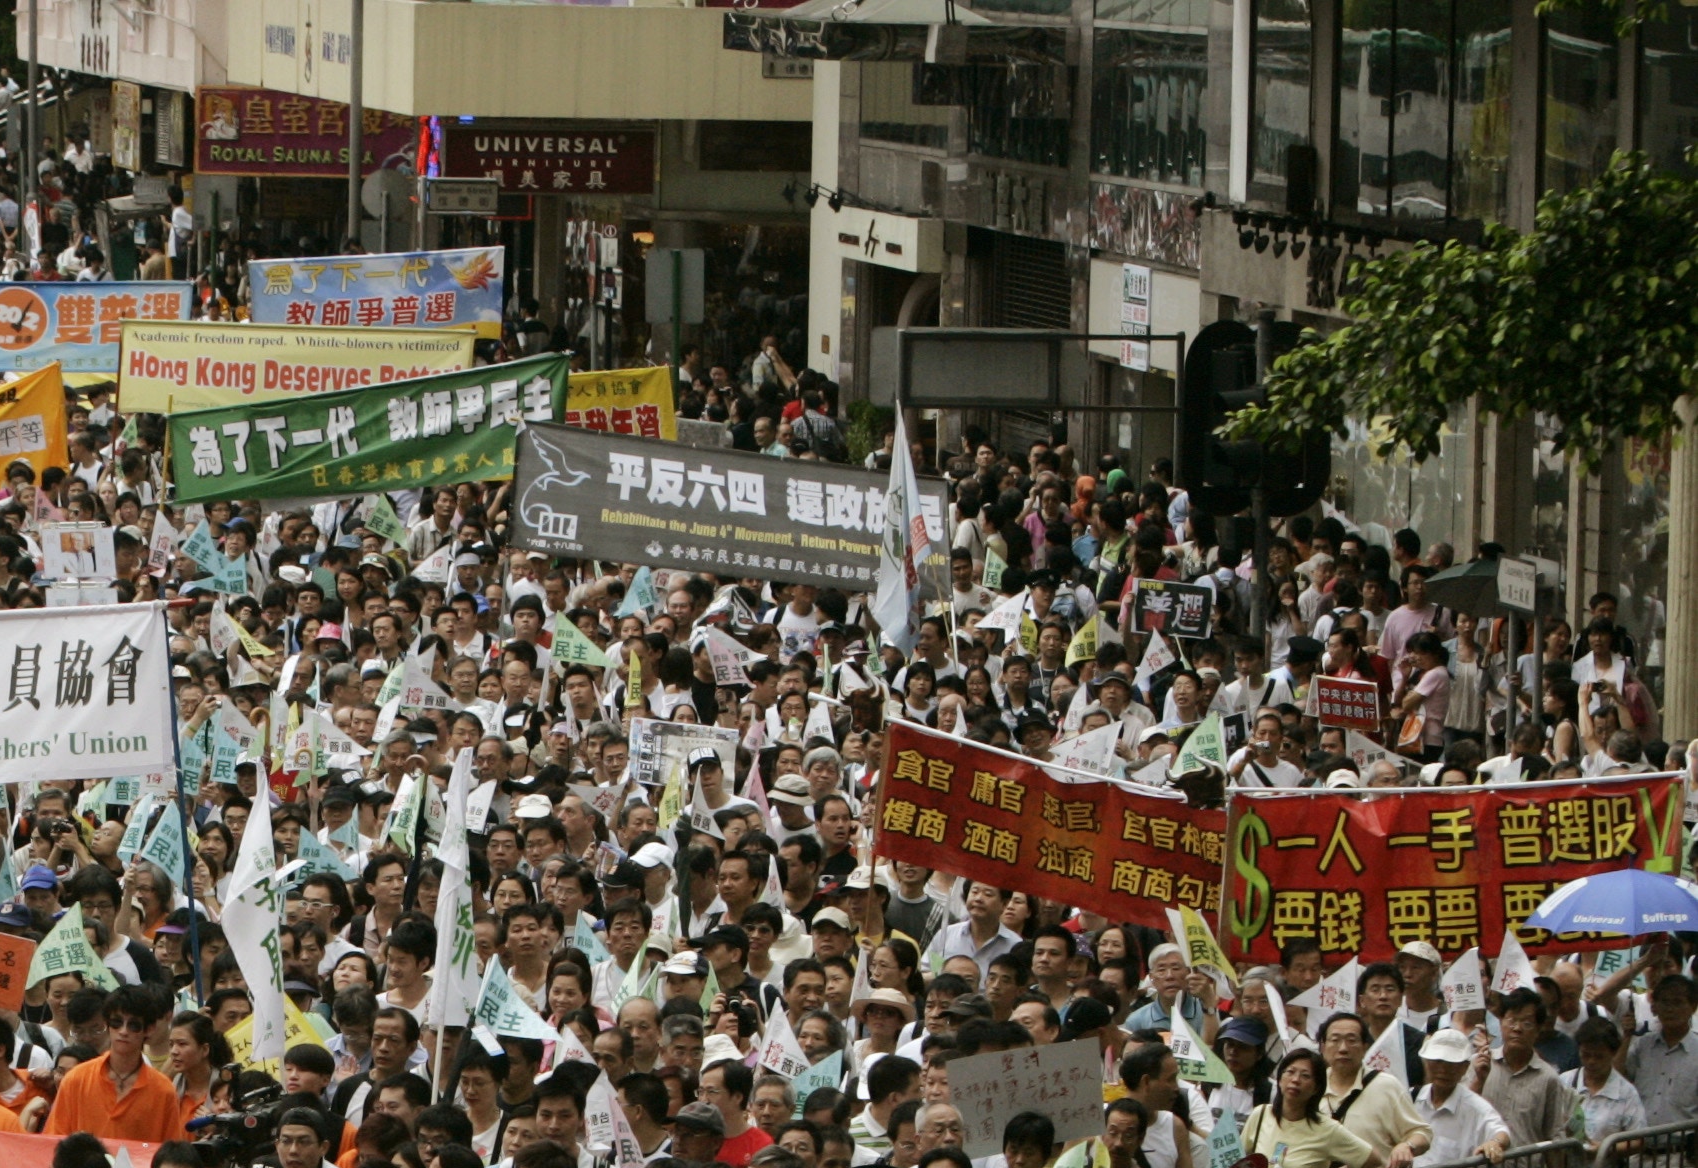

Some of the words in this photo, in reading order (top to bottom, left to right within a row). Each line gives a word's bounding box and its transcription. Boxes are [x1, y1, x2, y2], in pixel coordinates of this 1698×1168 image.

[272, 146, 333, 164] SAUNA
[337, 146, 374, 165] SA
[474, 136, 618, 155] UNIVERSAL
[480, 159, 613, 169] FURNITURE
[263, 257, 429, 295] 為了下一代
[53, 292, 182, 345] 雙普選
[285, 292, 457, 327] 教師爭普選
[131, 330, 191, 344] Academic
[193, 332, 244, 345] freedom
[247, 335, 288, 348] raped.
[295, 335, 394, 351] Whistle-blowers
[397, 339, 463, 352] victimized.
[128, 350, 189, 387] Hong
[195, 356, 257, 394] Kong
[263, 358, 372, 393] Deserves
[385, 374, 555, 441] 教師爭民主
[188, 404, 361, 478] 為了下一代
[605, 451, 768, 516] 平反六四
[600, 508, 667, 530] Rehabilitate
[669, 518, 688, 532] the
[688, 522, 717, 537] June
[800, 533, 837, 550] Return
[838, 538, 867, 554] Power
[552, 640, 588, 660] 民主
[68, 731, 149, 756] Union
[892, 749, 955, 794] 貪官
[969, 770, 1026, 815] 庸官
[882, 798, 949, 843] 樓商
[961, 819, 1021, 865] 酒商
[1275, 809, 1363, 874] 一人
[1388, 808, 1475, 872] 一手
[1499, 796, 1638, 867] 普選股
[1273, 890, 1364, 953] 要錢
[1387, 887, 1479, 950] 要票
[1571, 914, 1626, 925] Universal
[1641, 912, 1689, 923] Suffrage
[39, 942, 89, 971] 普選
[1454, 982, 1477, 994] 港台
[477, 1001, 525, 1034] 民主
